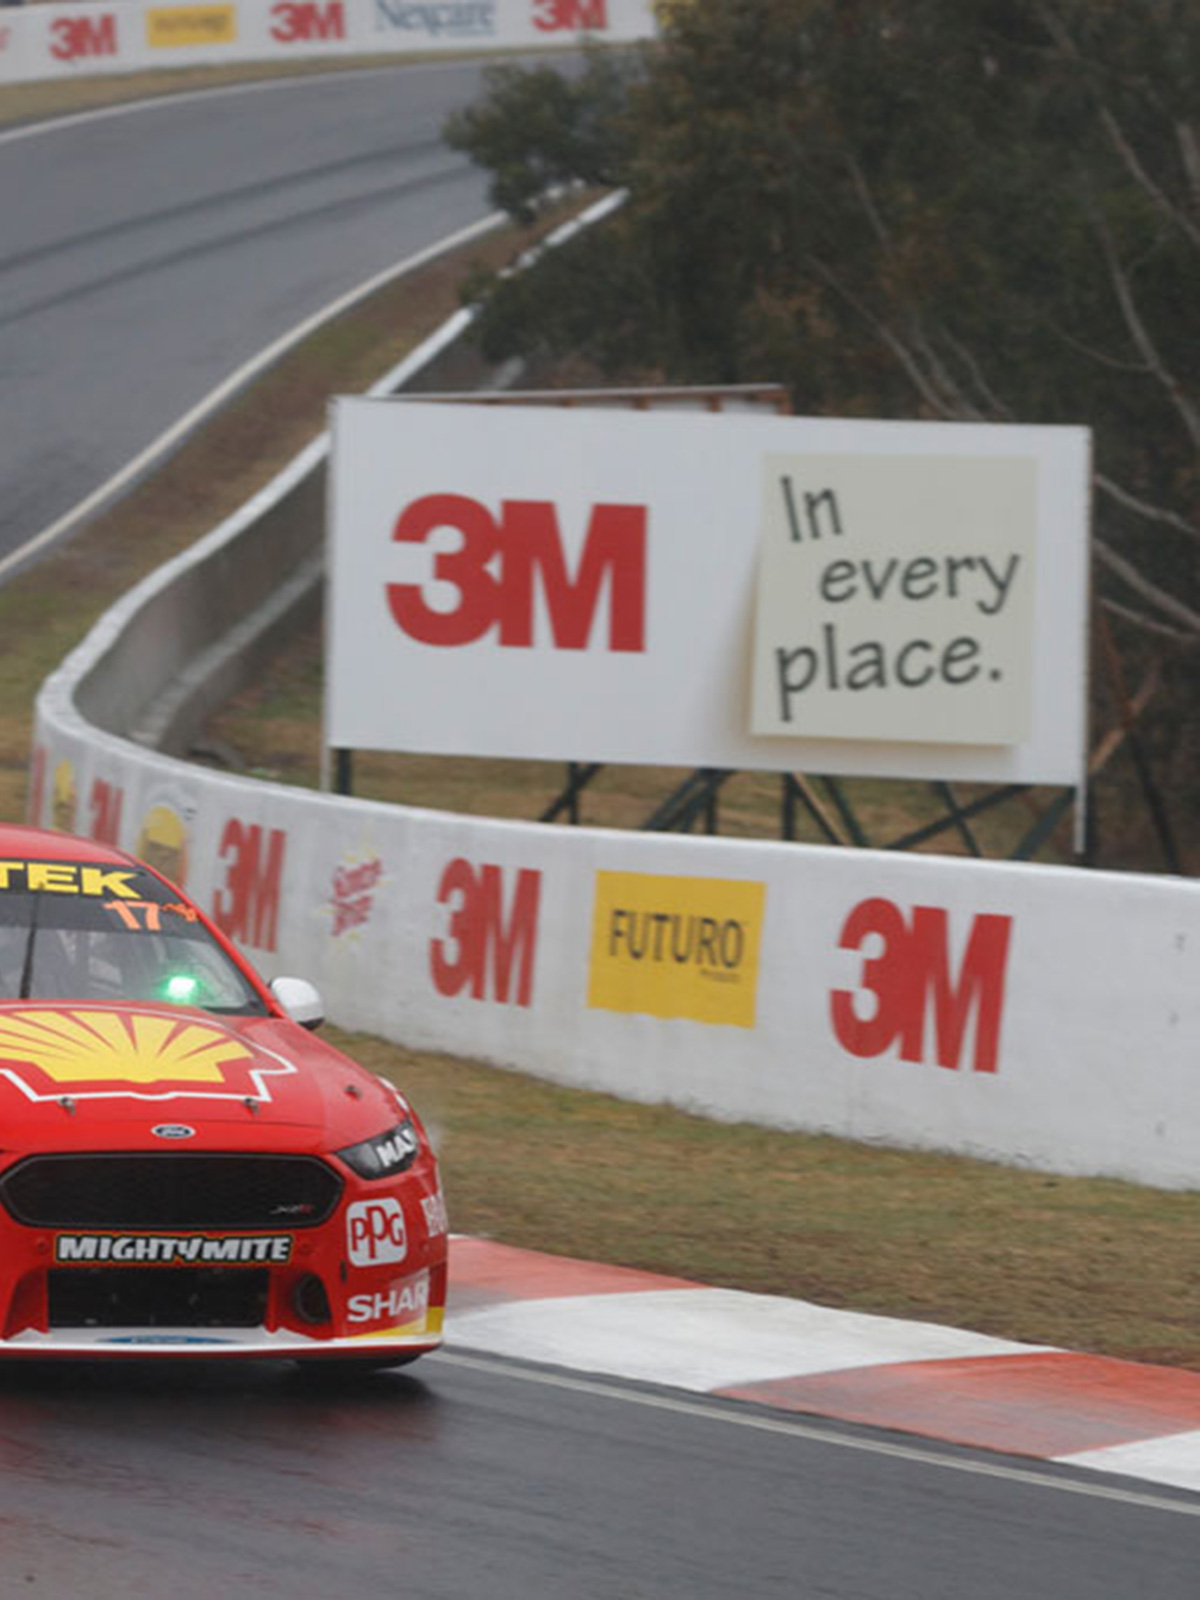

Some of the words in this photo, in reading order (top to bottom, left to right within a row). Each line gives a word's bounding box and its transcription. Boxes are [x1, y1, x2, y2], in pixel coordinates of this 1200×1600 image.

[50, 13, 117, 61] 3M
[270, 0, 345, 43] 3M
[532, 0, 607, 32] 3M
[780, 475, 844, 543] In
[385, 492, 649, 653] 3M
[820, 550, 1022, 617] every
[776, 623, 1005, 723] place.
[102, 899, 162, 932] 17
[213, 818, 286, 953] 3M
[429, 857, 542, 1008] 3M
[608, 909, 746, 969] FUTURO
[829, 896, 1014, 1074] 3M
[351, 1205, 404, 1260] PPG
